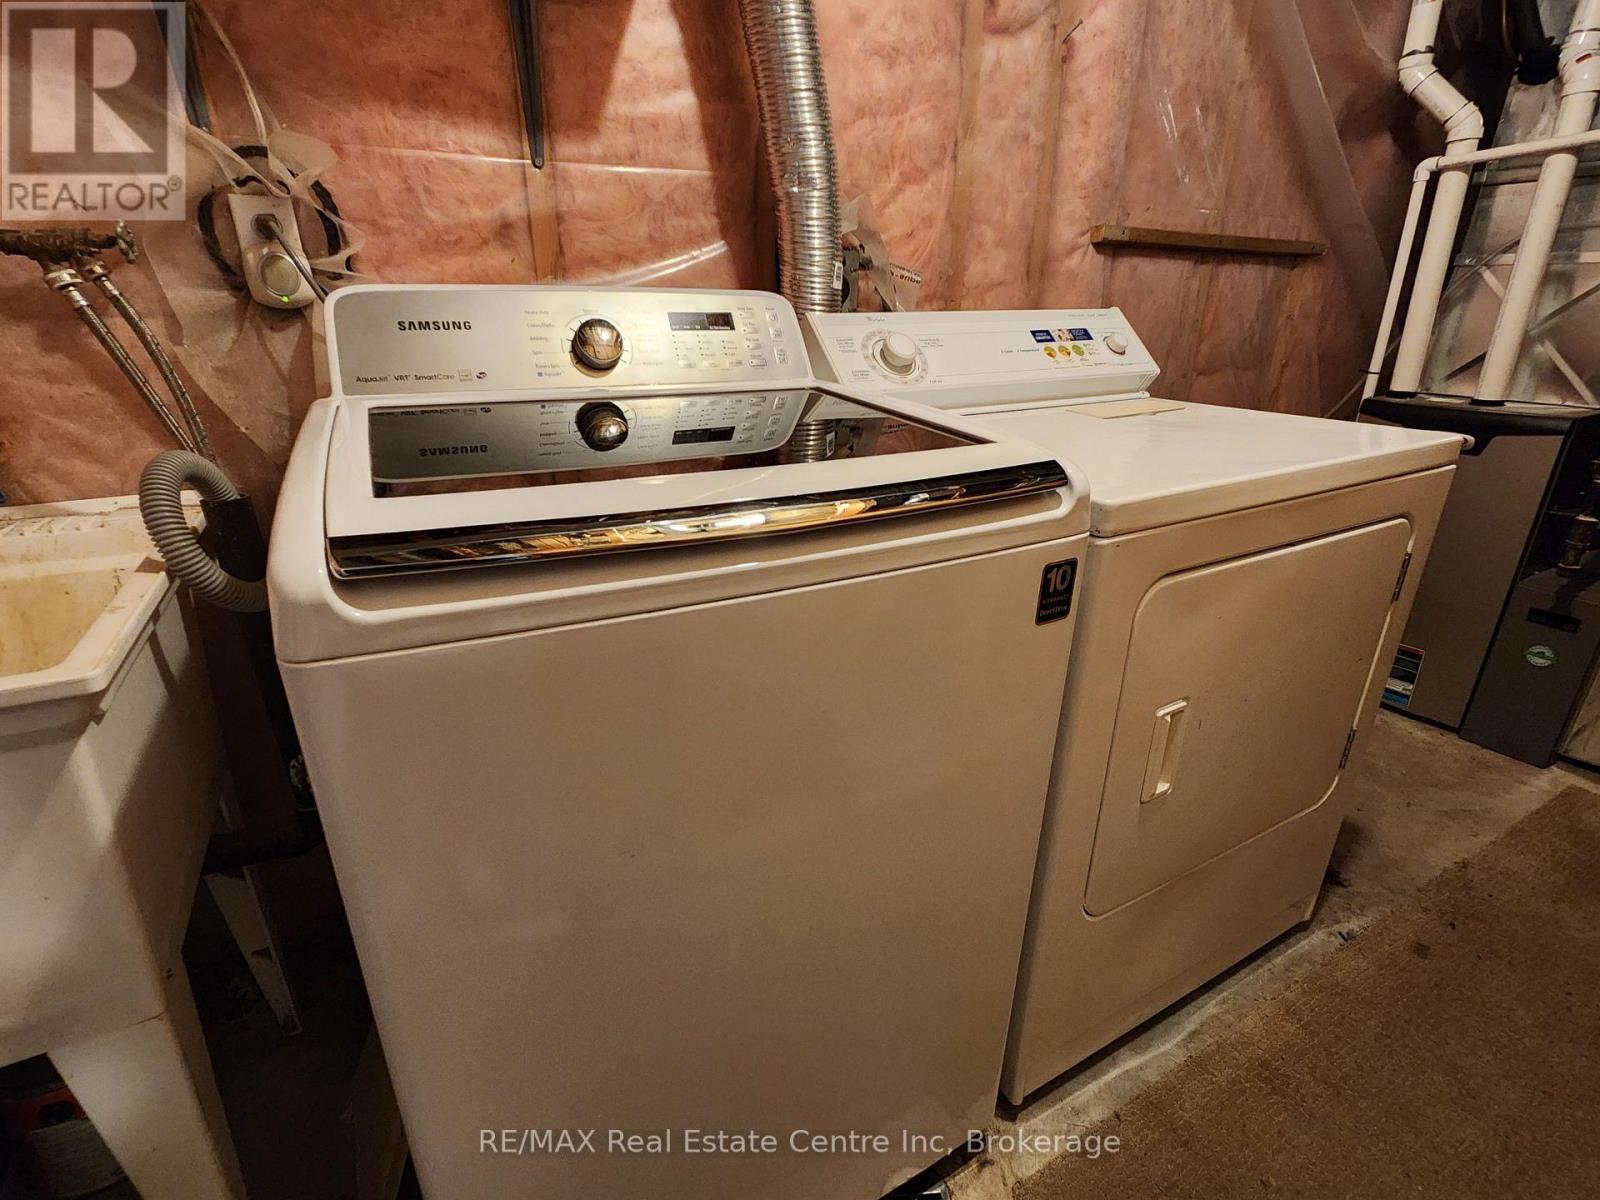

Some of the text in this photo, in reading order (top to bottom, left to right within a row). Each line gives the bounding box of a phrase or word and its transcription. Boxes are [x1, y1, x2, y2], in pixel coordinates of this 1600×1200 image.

[398, 320, 472, 331] SAMSUNG
[414, 373, 455, 382] SmartCare
[1047, 565, 1072, 593] 10
